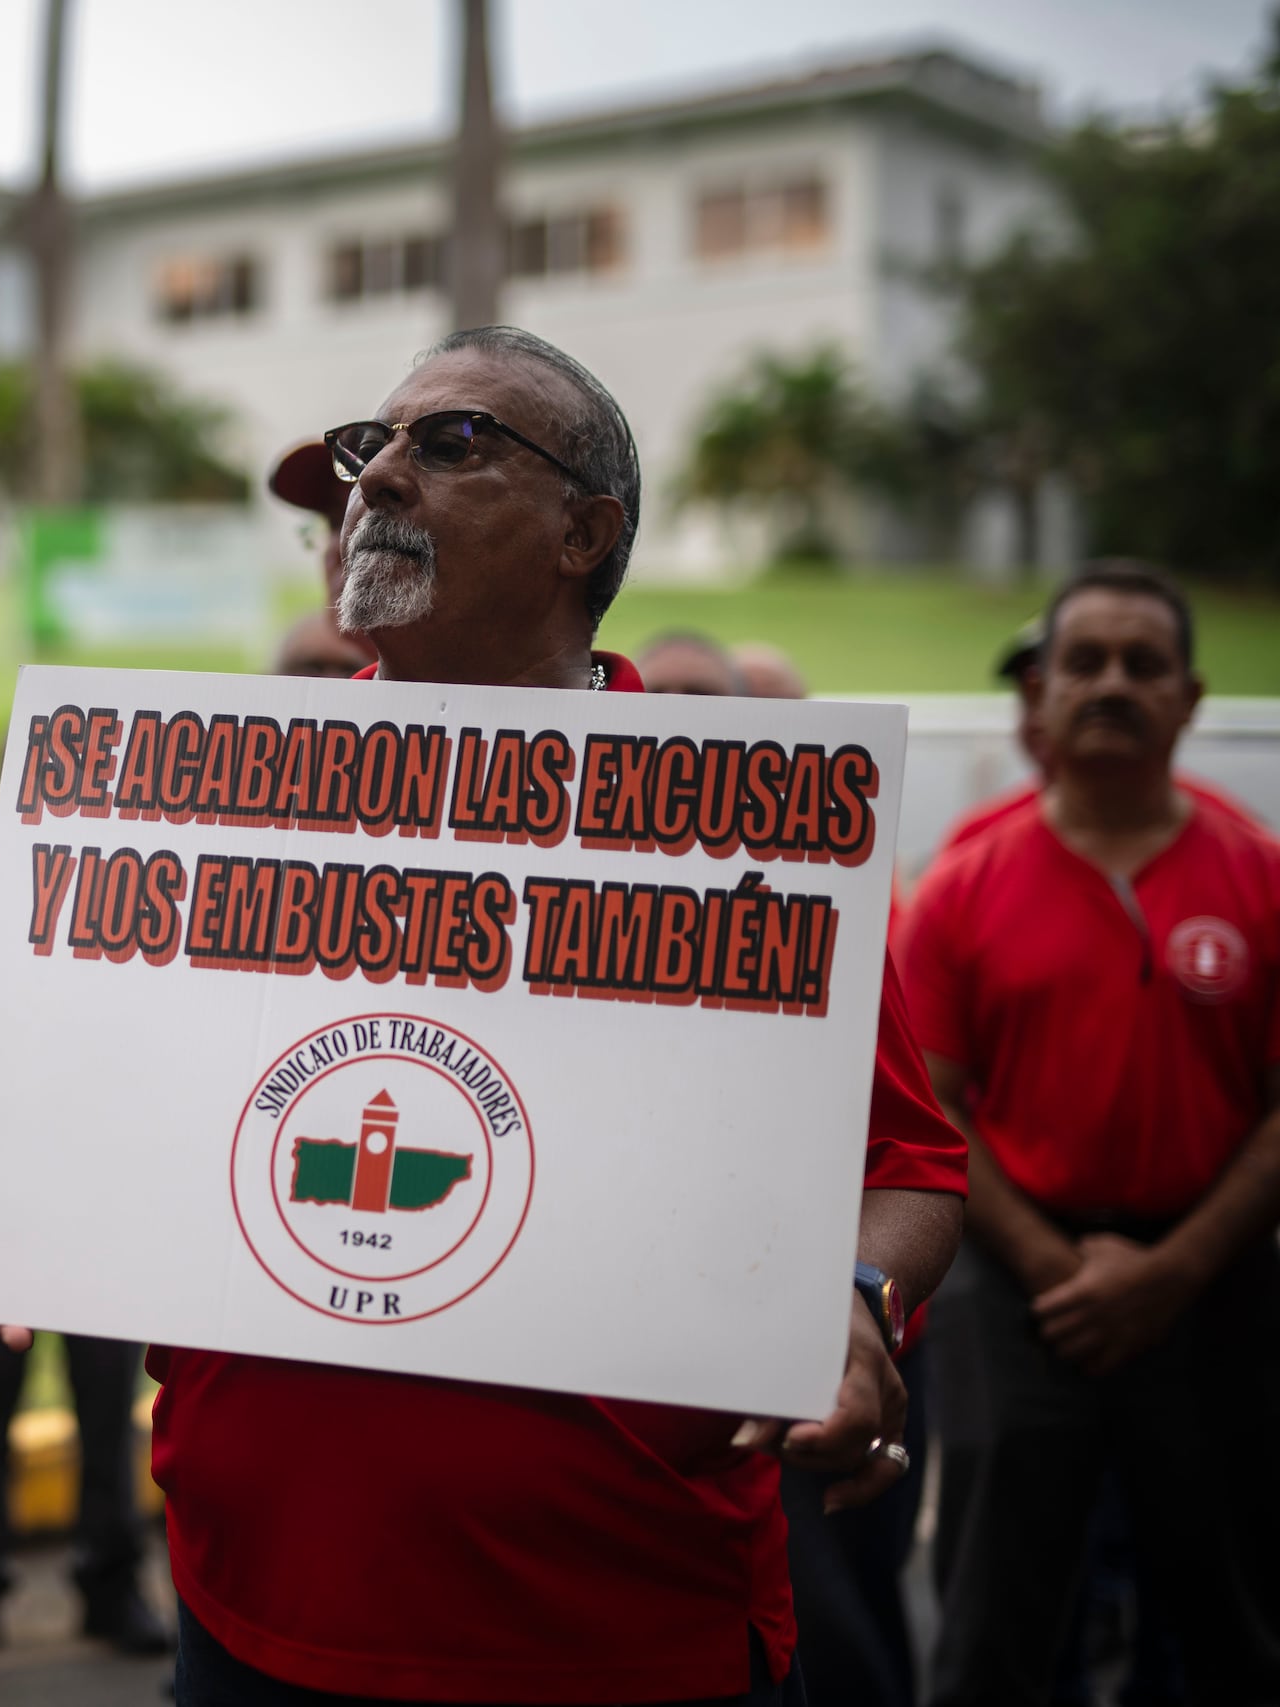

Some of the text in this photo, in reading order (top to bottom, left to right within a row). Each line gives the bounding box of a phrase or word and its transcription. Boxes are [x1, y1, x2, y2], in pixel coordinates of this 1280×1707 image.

[16, 704, 880, 868] ¡SE ACABARON LAS EXCUSAS
[28, 843, 840, 1018] Y LOS EMBUSTES TAMBIÉN!
[254, 1019, 522, 1138] SINDICATO DE TRABAJADORES
[339, 1229, 393, 1250] 1942
